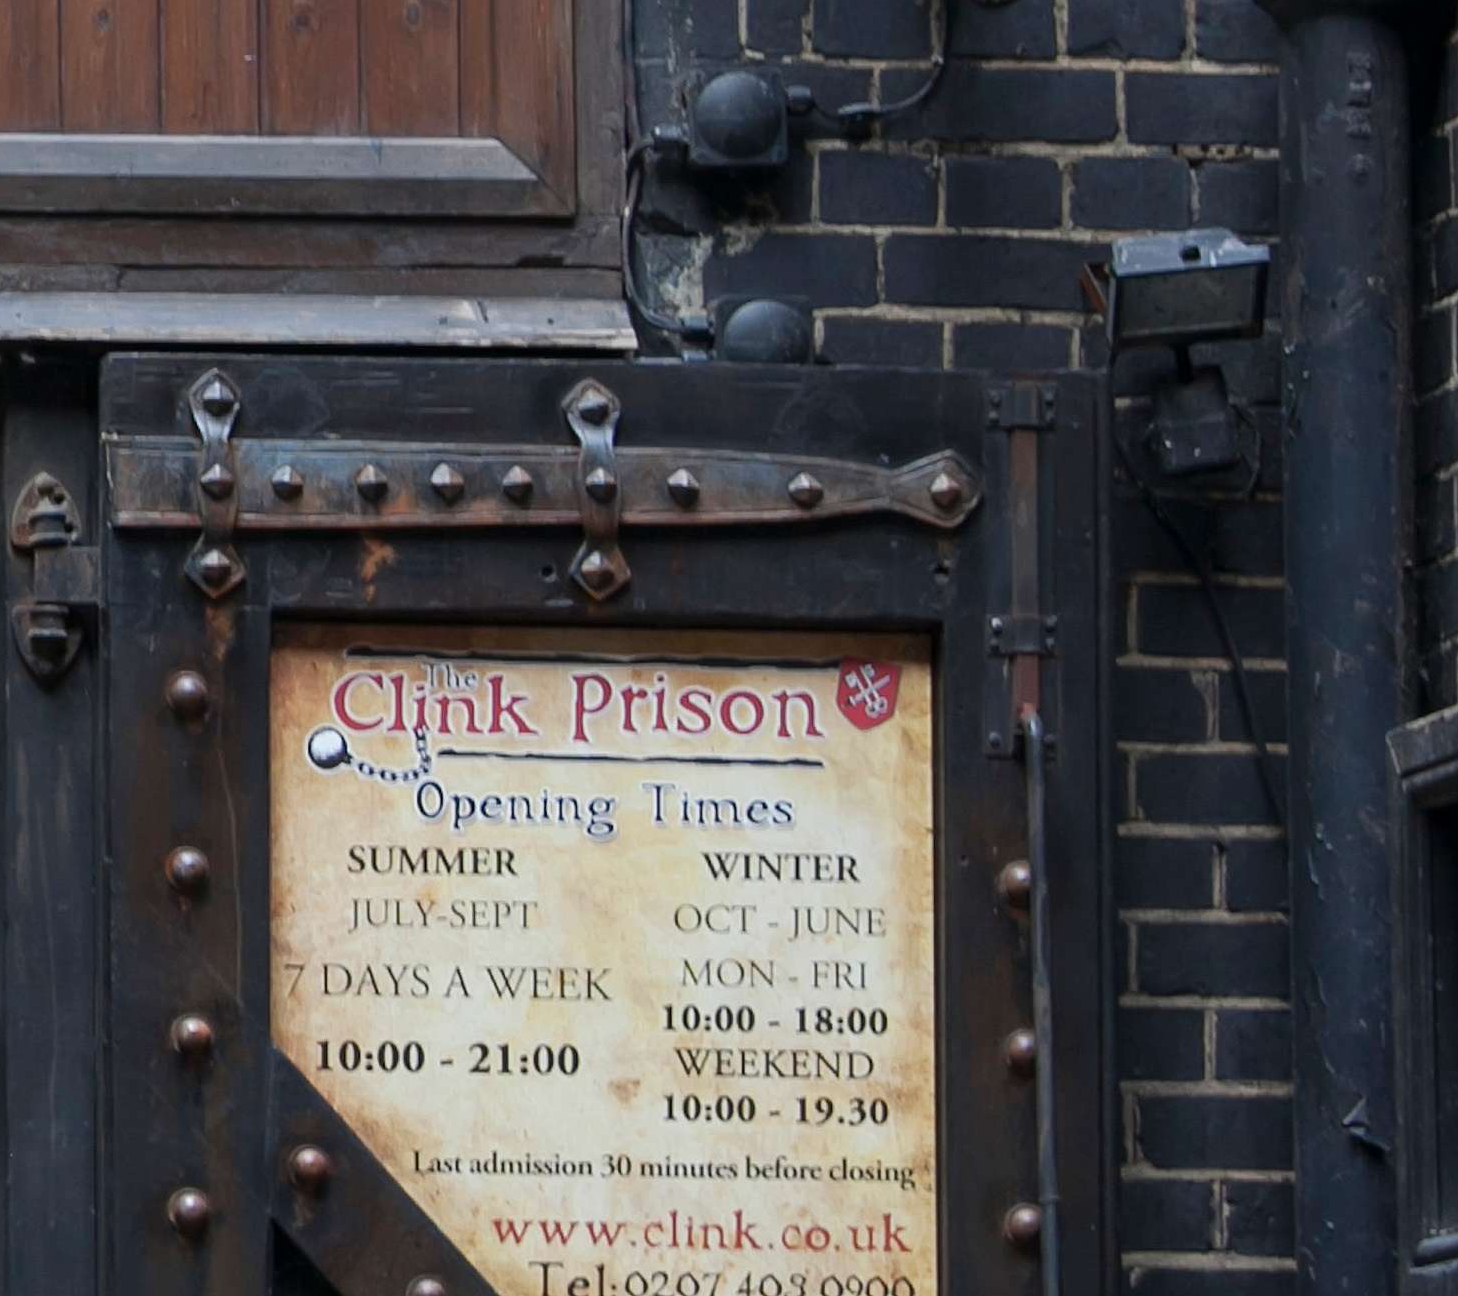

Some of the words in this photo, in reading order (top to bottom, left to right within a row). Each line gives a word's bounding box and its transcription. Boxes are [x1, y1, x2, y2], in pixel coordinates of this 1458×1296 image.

[420, 663, 477, 689] The
[333, 673, 536, 736] Clink
[573, 673, 824, 742] Prison
[416, 782, 616, 835] Opening
[643, 785, 794, 826] Times
[347, 846, 517, 877] SUMMER
[702, 853, 859, 883] WINTER
[349, 901, 537, 932] JULY-SEPT
[674, 906, 757, 935] OCT
[790, 908, 886, 938] JUNE
[284, 965, 305, 999] 7
[324, 965, 430, 999] DAYS
[444, 966, 471, 998] A
[484, 966, 613, 1001] WEEK
[681, 958, 775, 989] MON
[811, 961, 867, 991] FRI
[661, 1005, 756, 1033] 10:00
[794, 1006, 887, 1035] 18:00
[316, 1039, 425, 1073] 10:00
[469, 1042, 580, 1076] 21:00
[675, 1049, 874, 1079] WEEKEND
[661, 1095, 756, 1123] 10:00
[794, 1096, 887, 1126] 19.30
[413, 1151, 463, 1175] Last
[469, 1151, 593, 1178] admission
[600, 1156, 631, 1178] 30
[640, 1156, 736, 1181] minutes
[744, 1156, 823, 1182] before
[828, 1157, 916, 1189] closing
[492, 1211, 913, 1255] www.clink.co.uk
